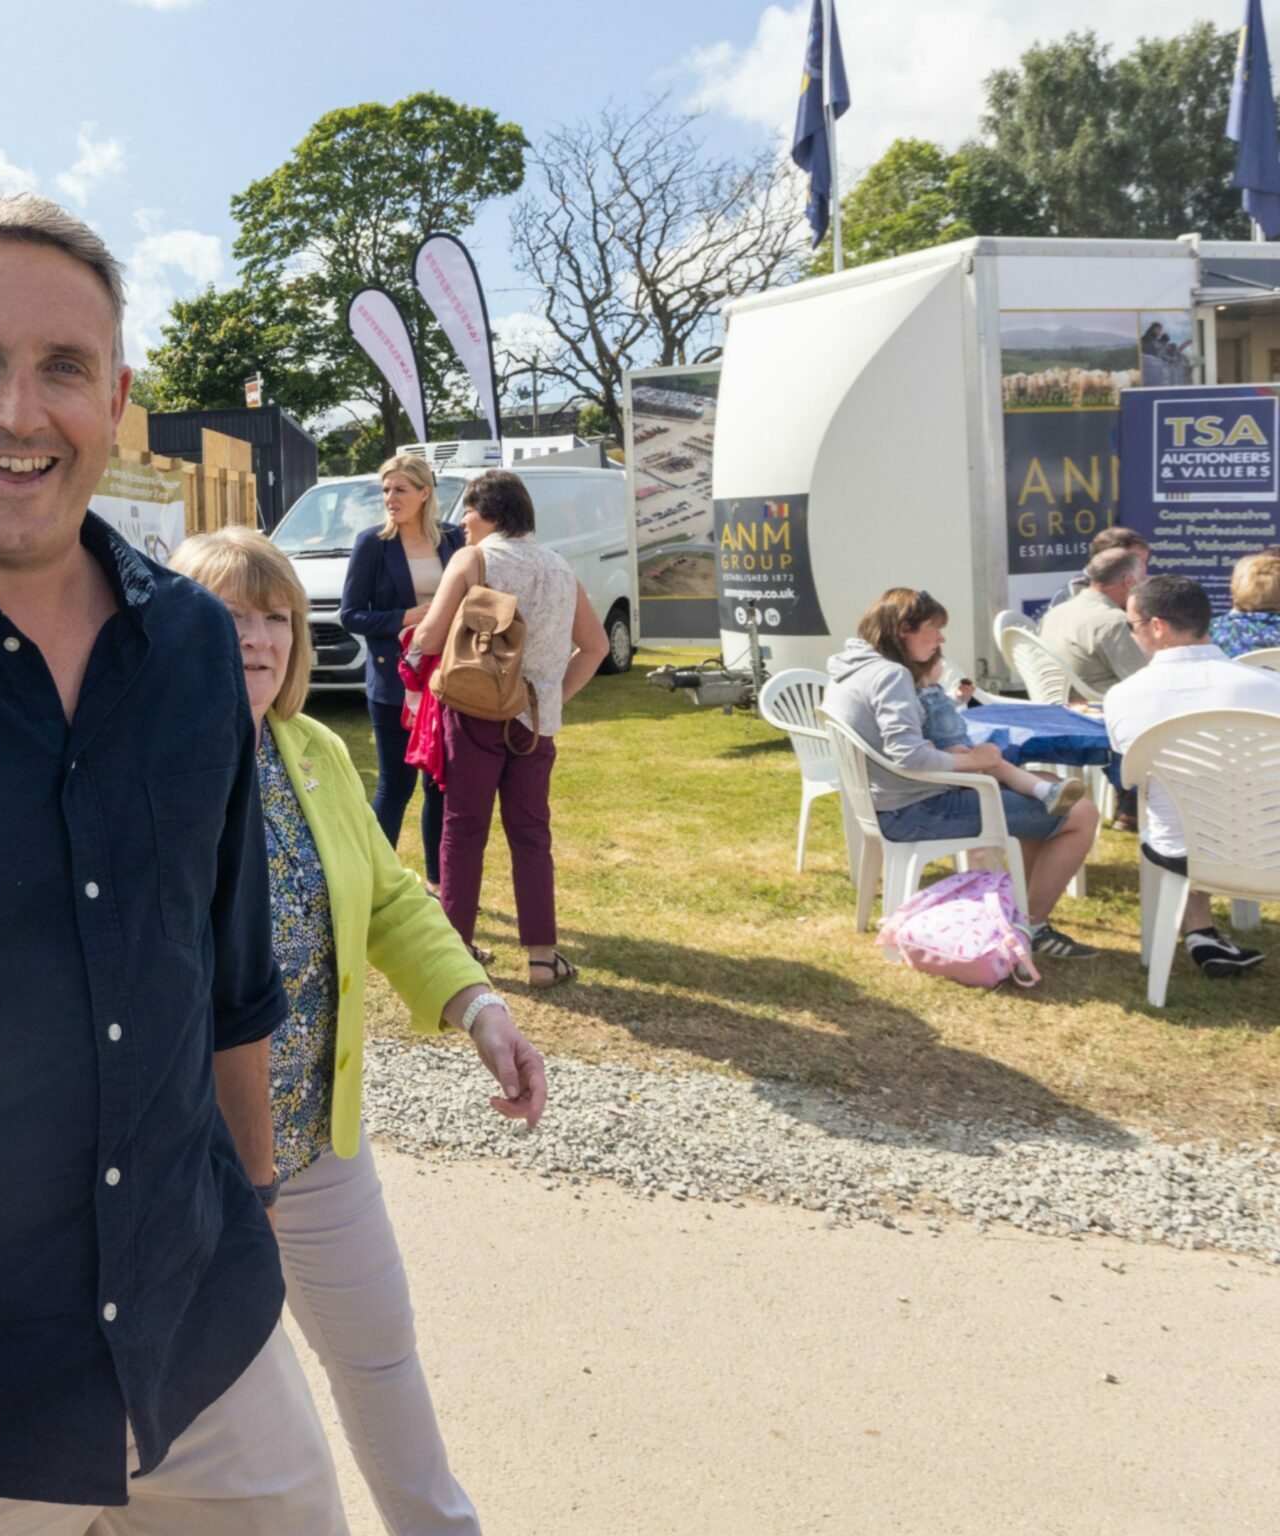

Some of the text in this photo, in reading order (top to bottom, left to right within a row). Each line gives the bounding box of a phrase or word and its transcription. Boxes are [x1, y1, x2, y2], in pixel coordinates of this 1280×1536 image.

[1164, 415, 1268, 446] TSA
[1161, 451, 1270, 465] AUCTIONEERS
[1161, 466, 1270, 478] & VALUERS
[721, 521, 790, 551] ANM
[1154, 524, 1276, 535] and Professional
[1019, 542, 1093, 558] ESTABLIS
[721, 553, 793, 570] GROUP
[722, 573, 769, 582] ESTABLISHED
